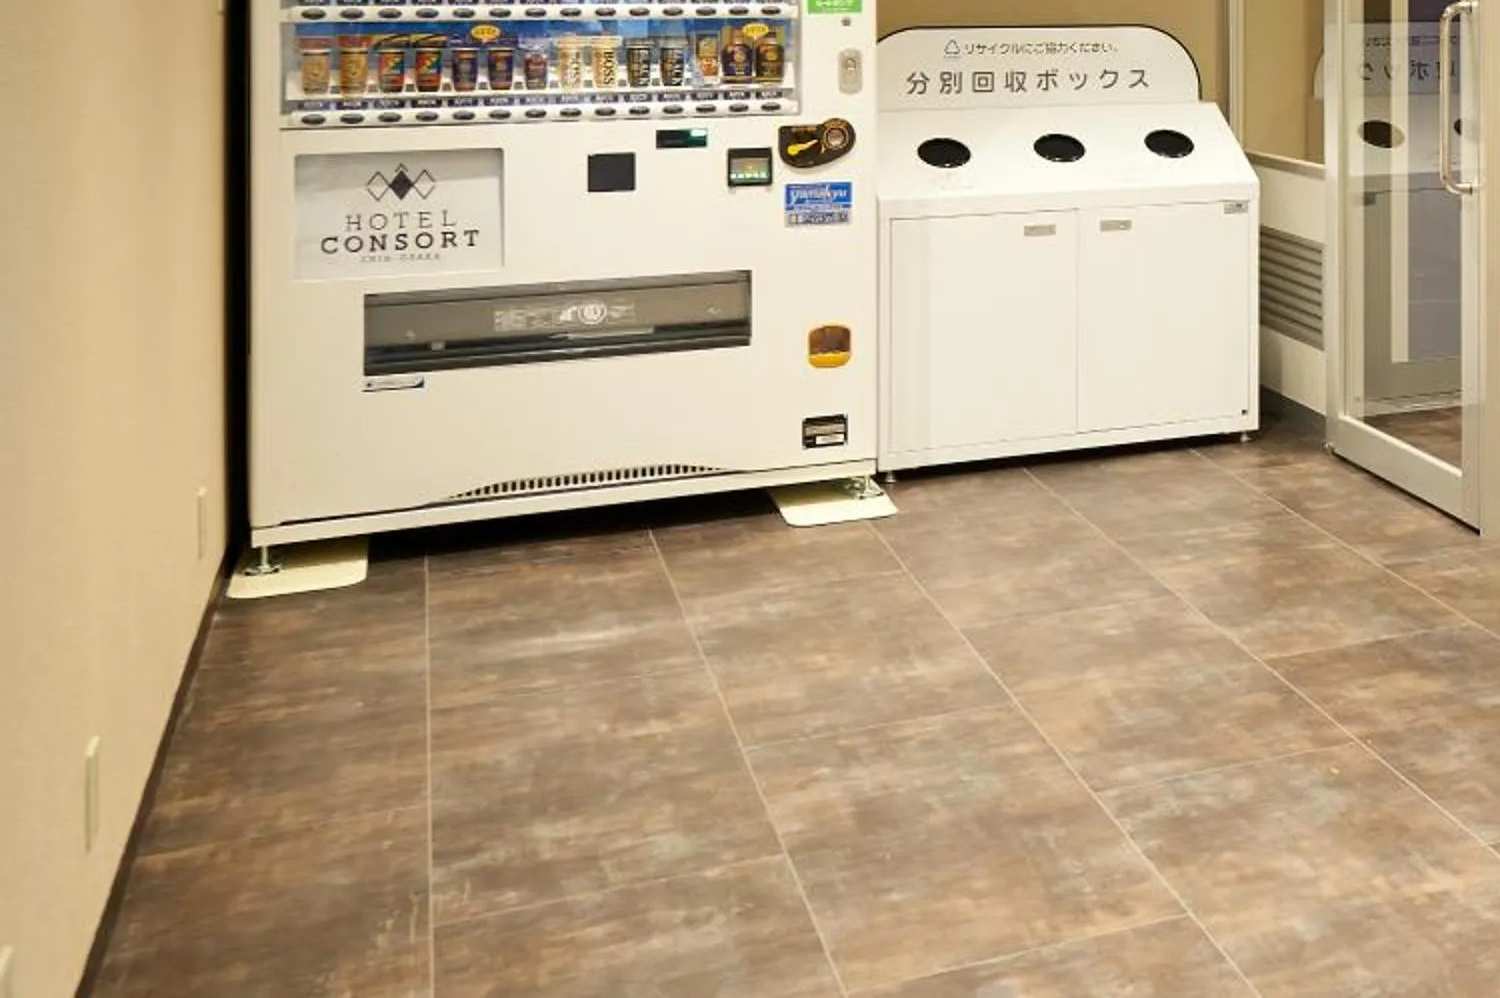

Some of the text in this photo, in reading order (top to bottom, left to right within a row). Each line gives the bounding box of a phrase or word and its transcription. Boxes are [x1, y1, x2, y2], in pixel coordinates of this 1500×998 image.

[603, 50, 615, 85] BOSS
[906, 68, 1150, 95] 分別回収ボックス
[345, 210, 457, 231] HOTEL
[320, 229, 480, 254] CONSORT
